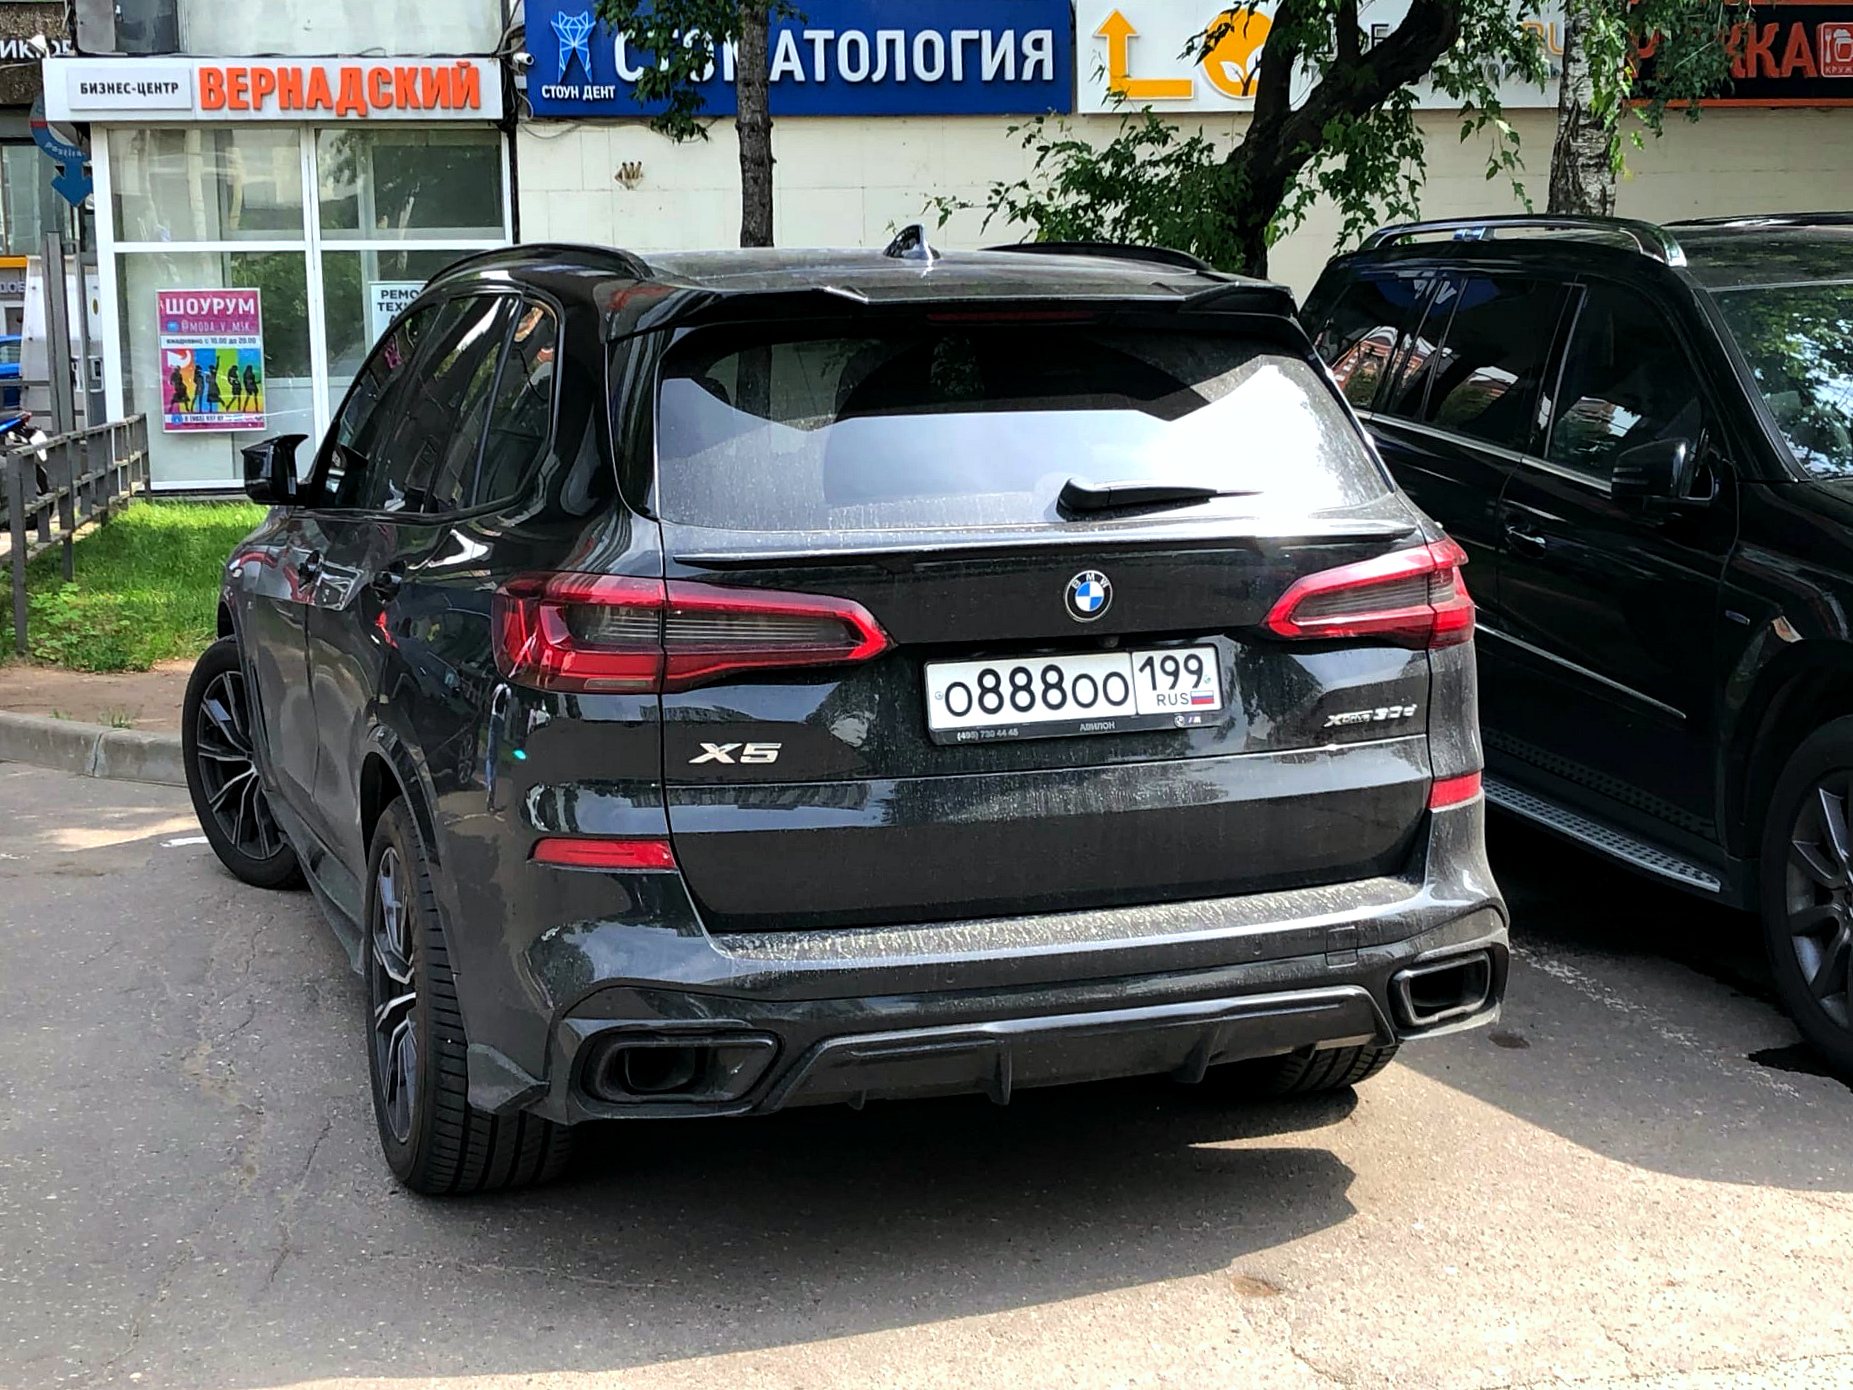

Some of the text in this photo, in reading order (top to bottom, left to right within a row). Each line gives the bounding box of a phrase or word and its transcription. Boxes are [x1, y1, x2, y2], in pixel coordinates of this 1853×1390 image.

[80, 82, 179, 97] БИЗНЕС-ЦЕНТР
[198, 61, 481, 117] ВЕРНАДСКИЙ
[541, 84, 616, 101] СТОУН ДЕНТ
[380, 289, 420, 300] РЕМО
[165, 297, 255, 315] ШОУРУМ
[377, 302, 408, 312] ТЕХ
[1071, 572, 1110, 590] BMW
[1138, 653, 1204, 691] 199
[1156, 692, 1190, 707] RUS
[688, 742, 782, 764] X5
